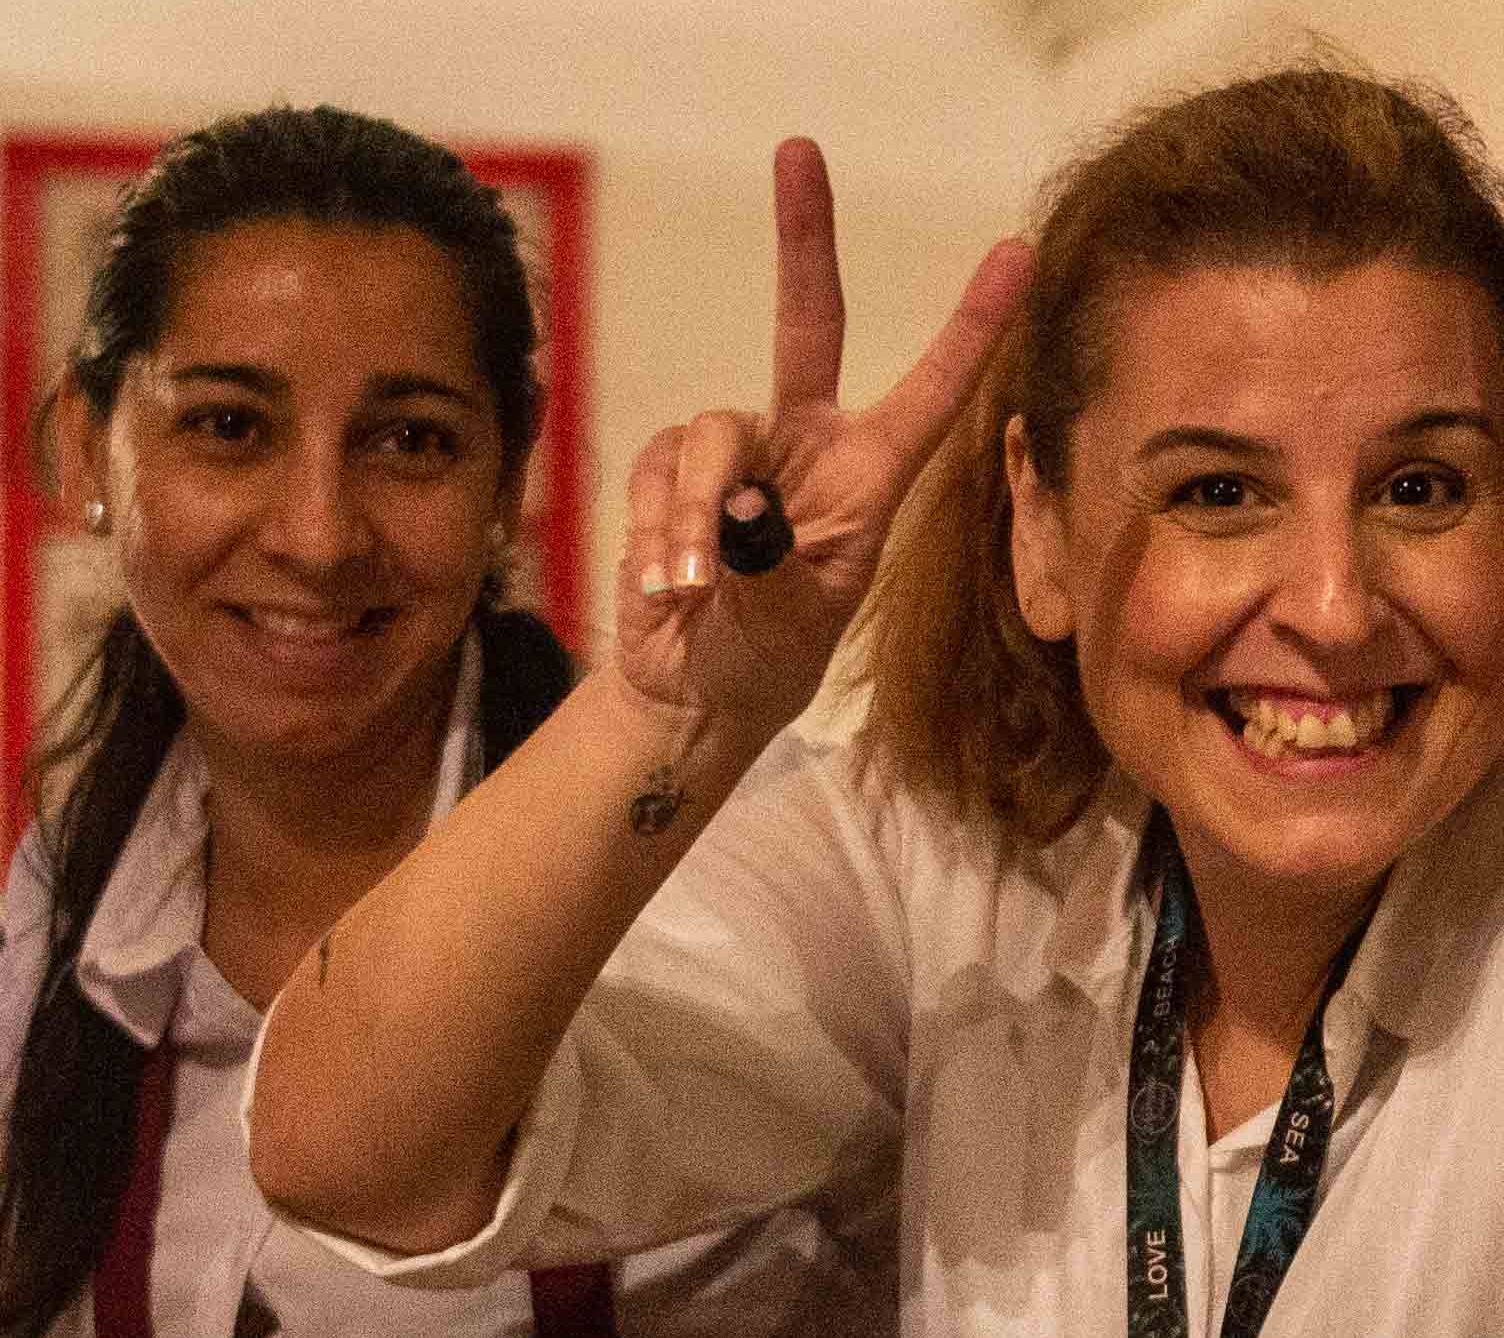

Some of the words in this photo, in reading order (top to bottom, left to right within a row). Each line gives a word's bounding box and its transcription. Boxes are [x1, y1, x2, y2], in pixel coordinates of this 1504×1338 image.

[1153, 934, 1180, 1017] BEACH
[1279, 1111, 1309, 1165] SEA
[1146, 1227, 1169, 1303] LOVE
